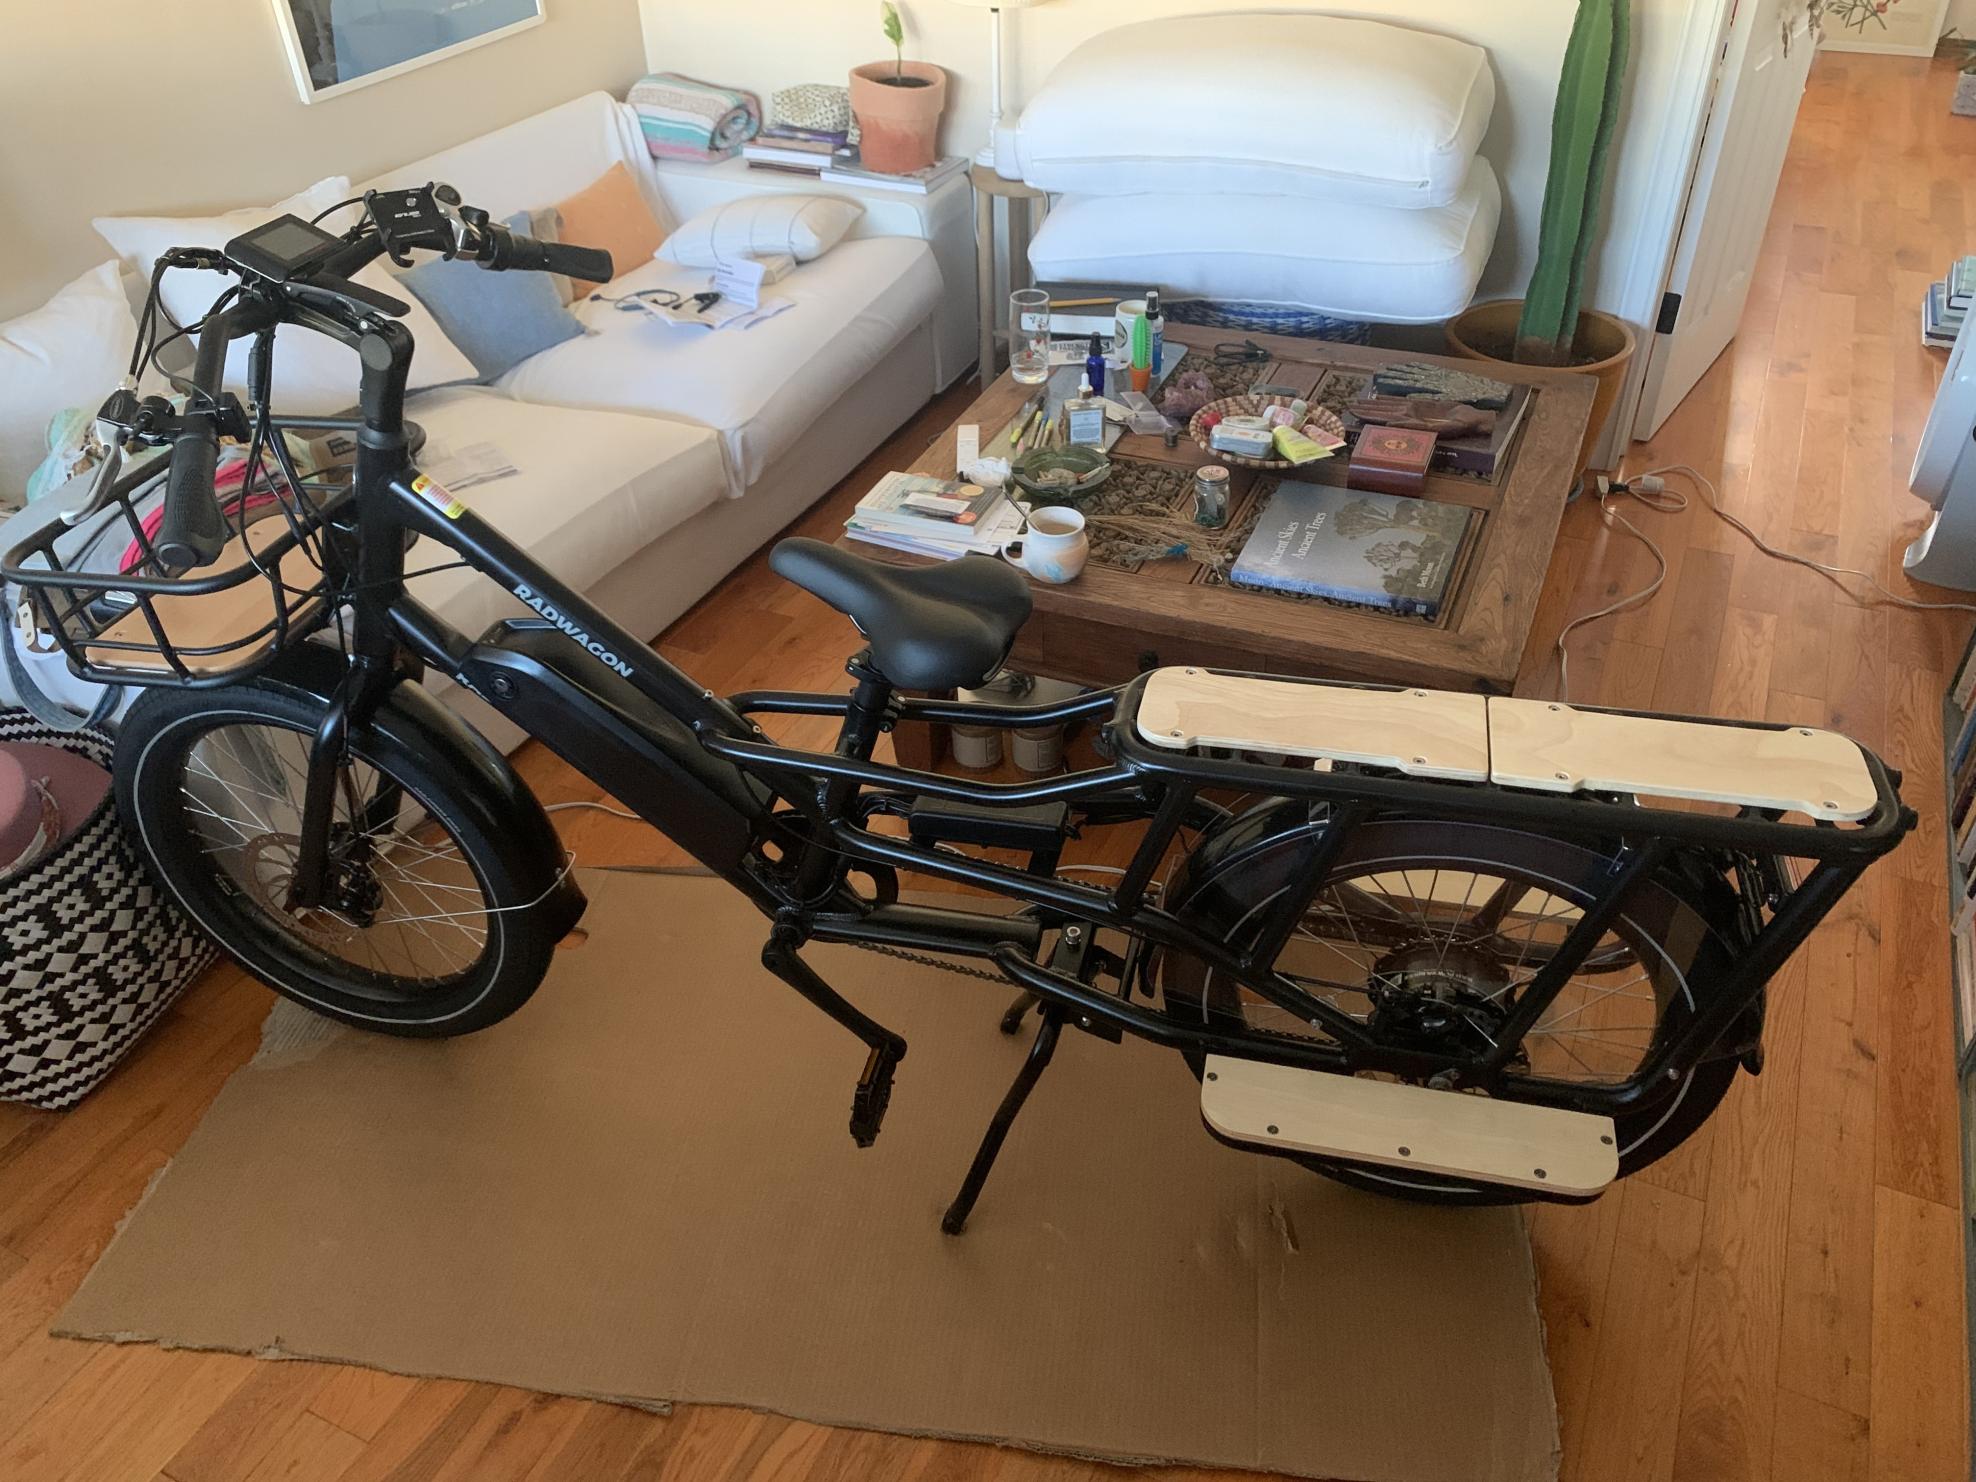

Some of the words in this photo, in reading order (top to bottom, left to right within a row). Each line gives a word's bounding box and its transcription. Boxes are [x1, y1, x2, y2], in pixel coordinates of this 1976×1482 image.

[1263, 540, 1290, 567] Ancient
[1279, 521, 1299, 541] Skies
[1291, 531, 1317, 560] Ancient
[1304, 512, 1328, 530] Trees
[513, 584, 634, 678] RADWAGON
